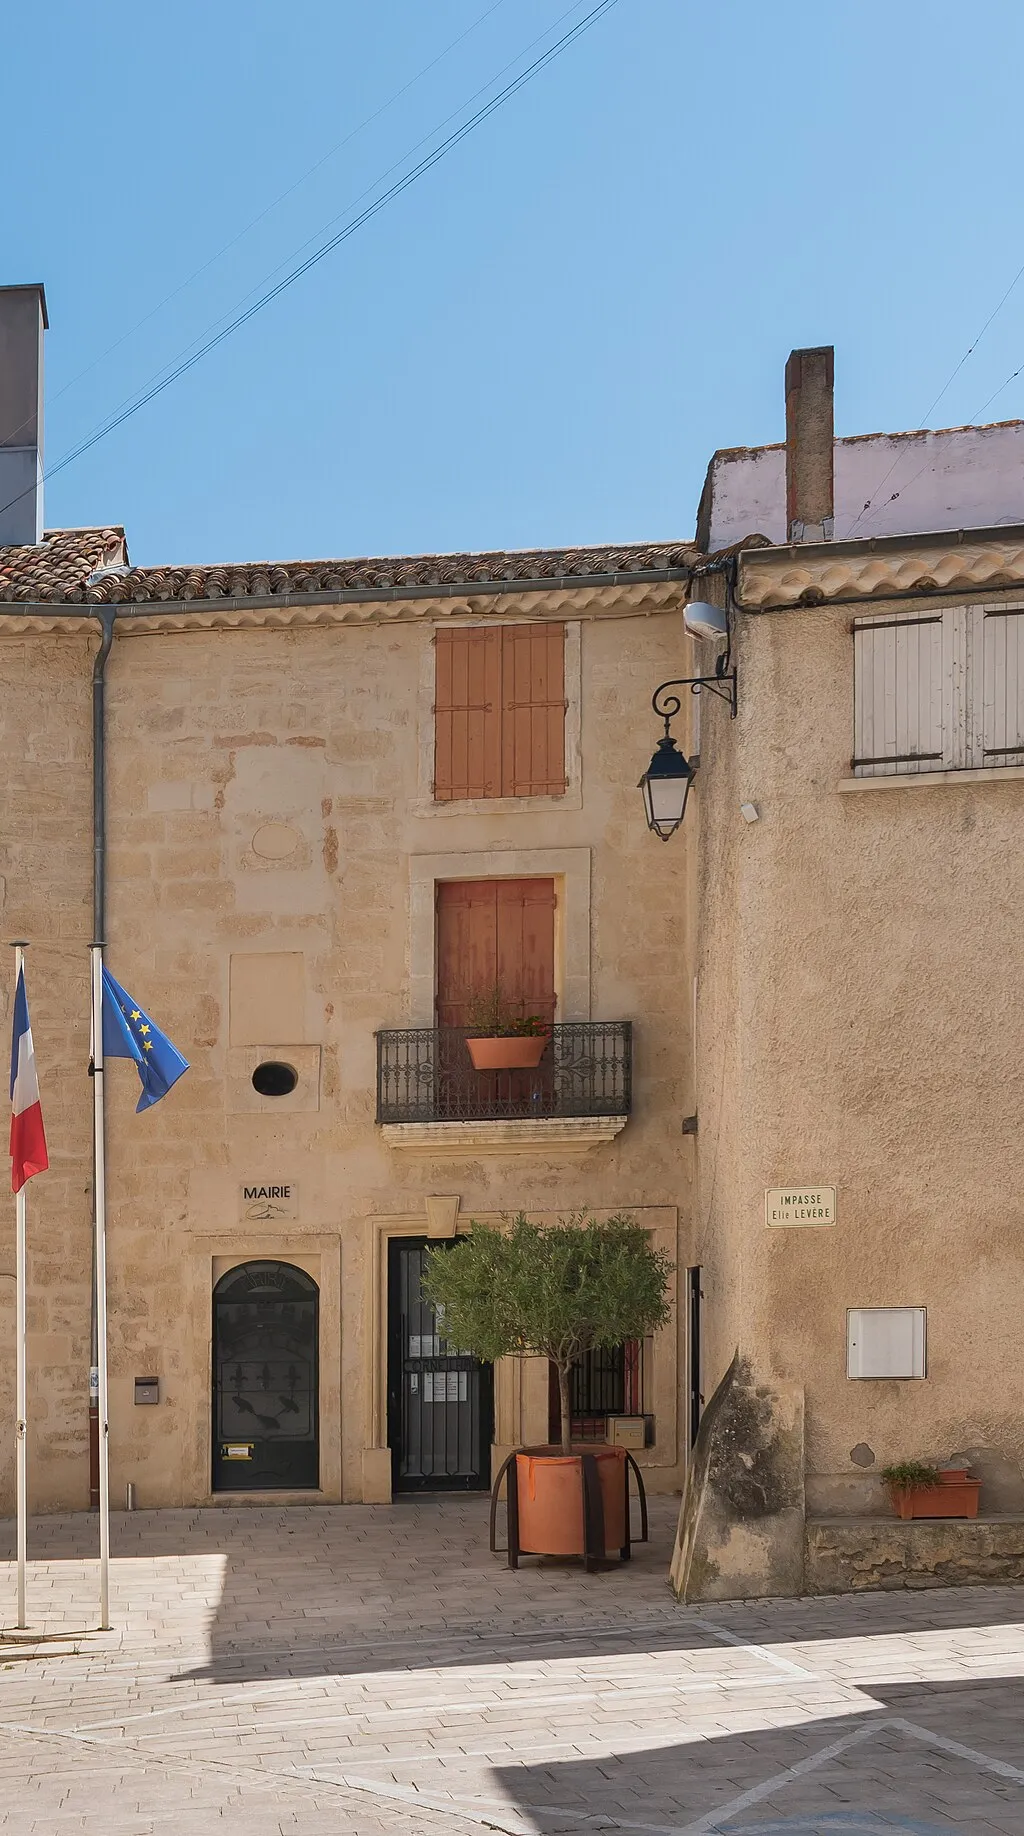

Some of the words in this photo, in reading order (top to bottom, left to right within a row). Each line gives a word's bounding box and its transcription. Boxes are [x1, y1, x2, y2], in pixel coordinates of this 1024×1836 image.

[244, 1186, 290, 1199] MAIRIE
[780, 1194, 822, 1205] IMPASSE
[772, 1210, 790, 1220] Elie
